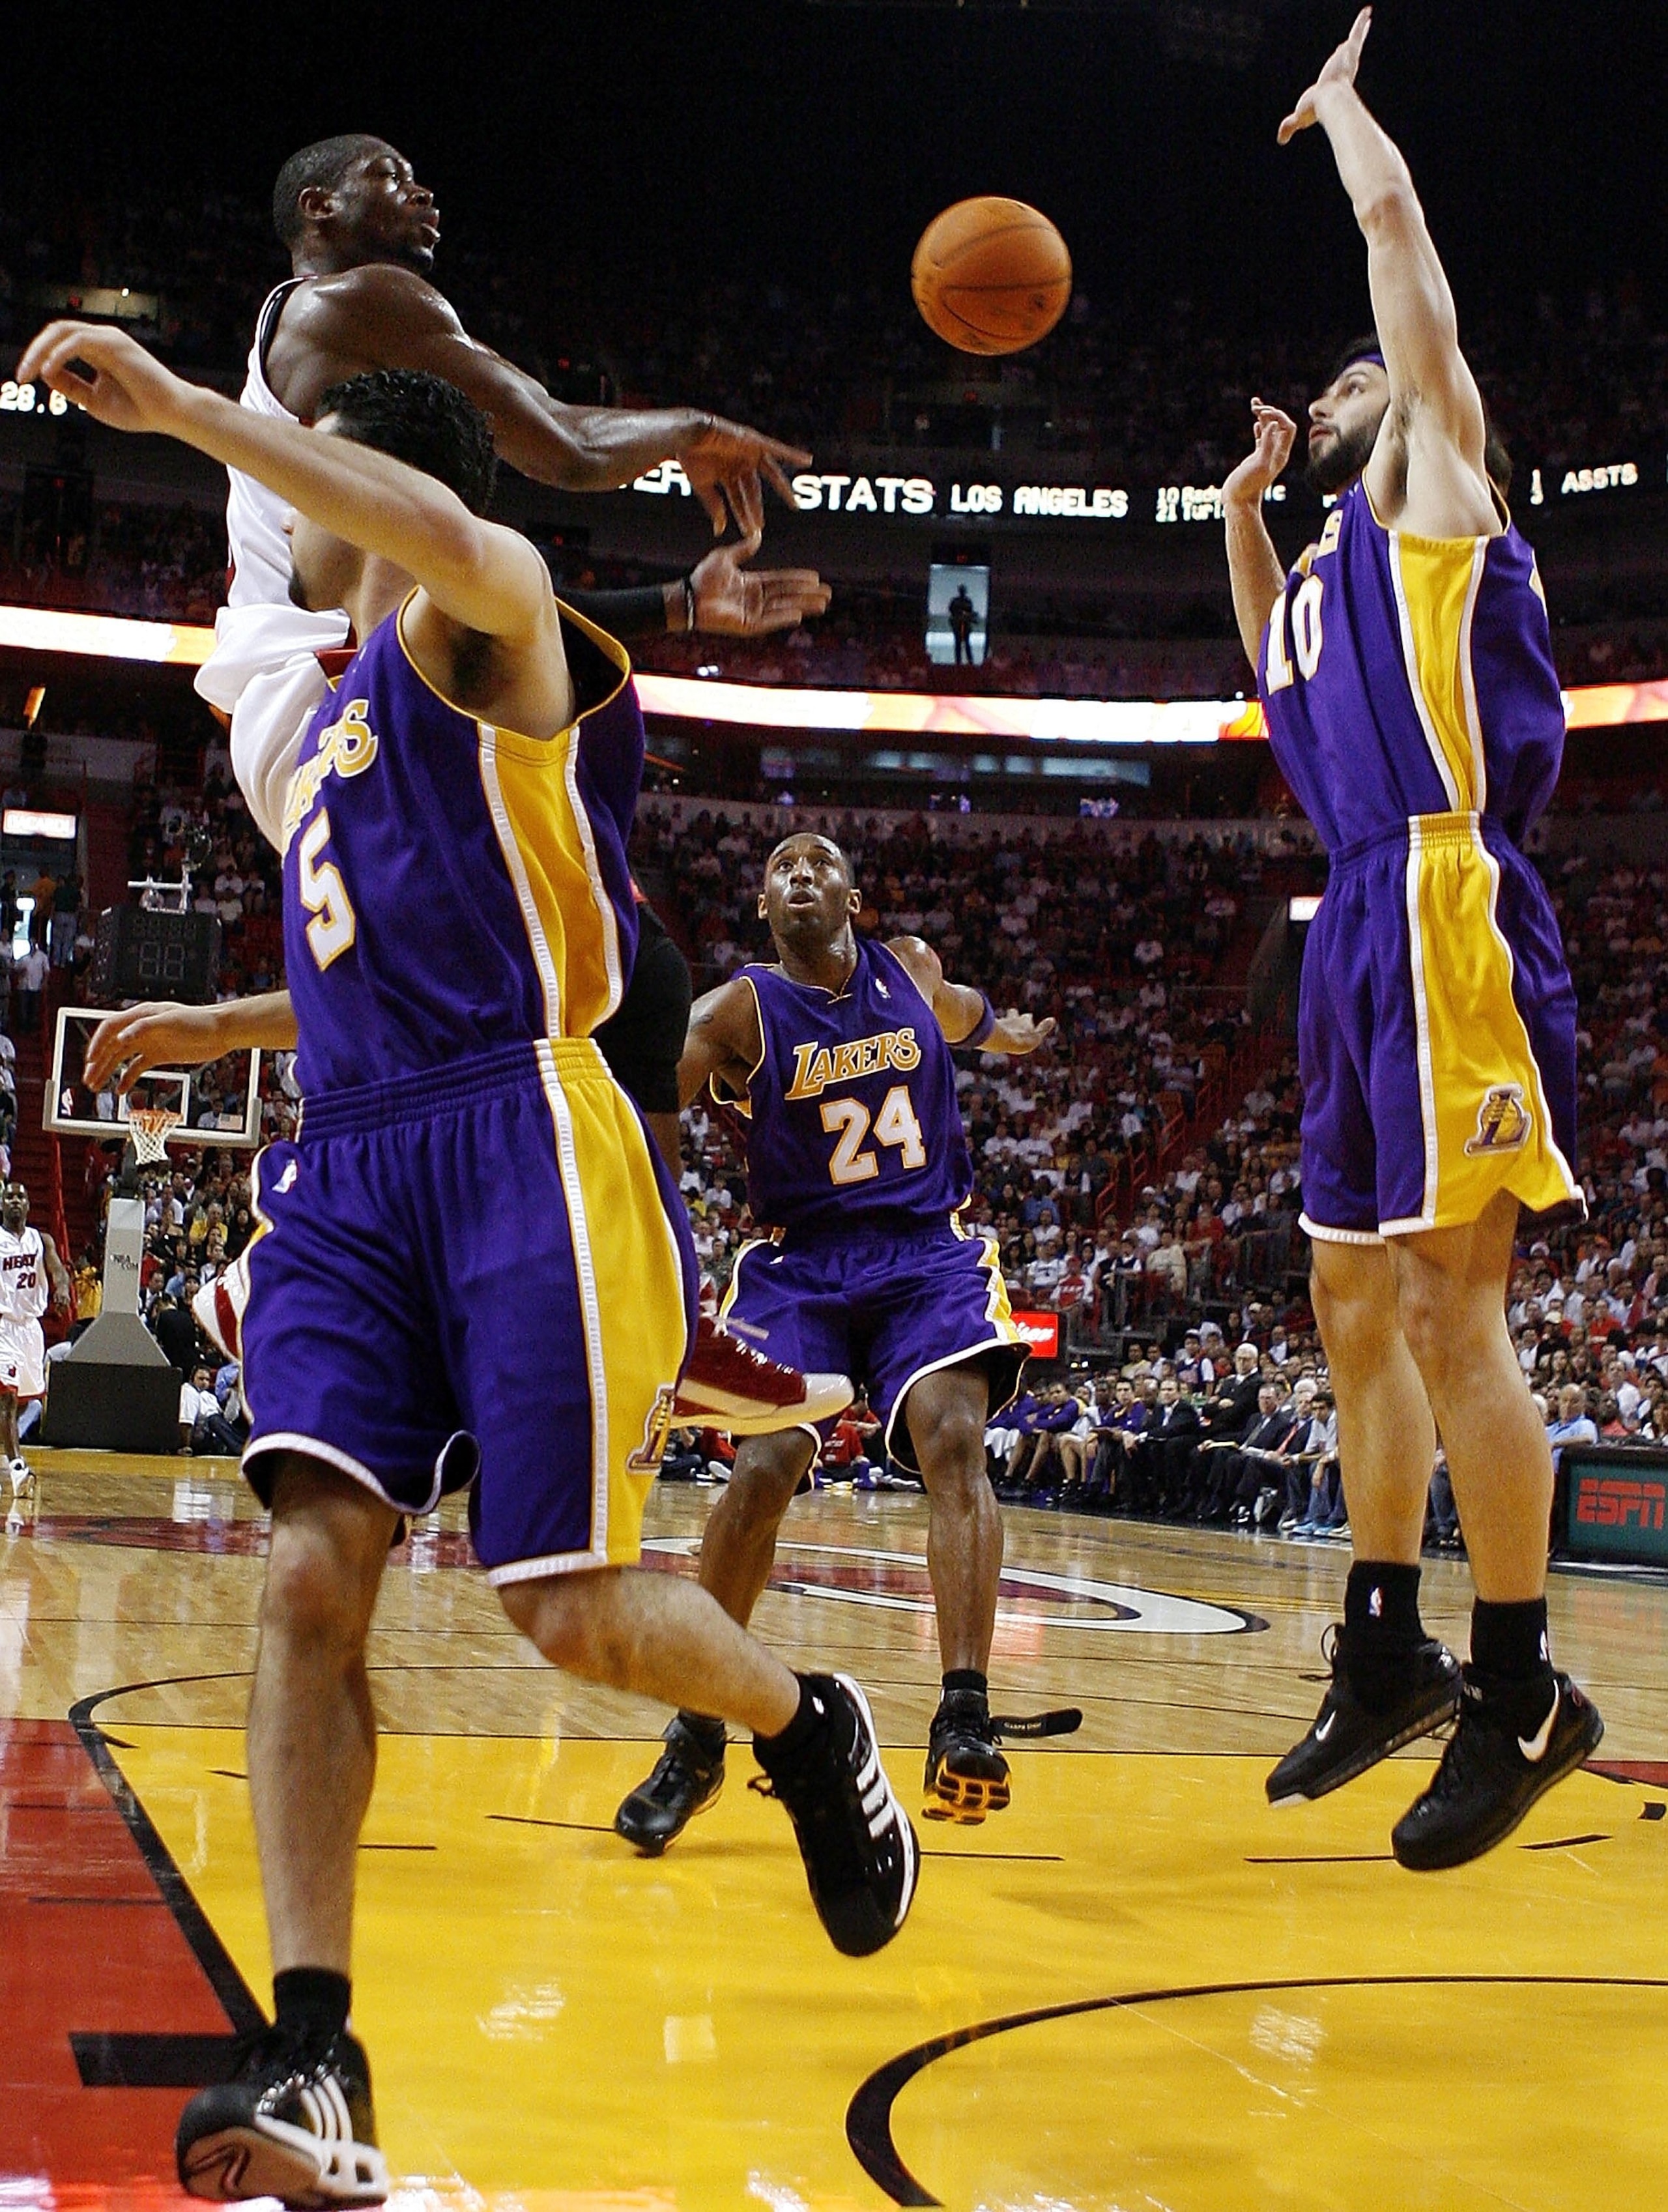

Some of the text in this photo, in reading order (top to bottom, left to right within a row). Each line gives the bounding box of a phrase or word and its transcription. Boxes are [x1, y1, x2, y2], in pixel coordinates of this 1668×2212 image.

[792, 474, 934, 515] STATS
[951, 483, 1003, 513] LOS
[1013, 486, 1129, 519] ANGELES
[1265, 573, 1324, 696] 10
[299, 805, 356, 972] 5
[784, 1027, 921, 1100] LAKERS
[820, 1085, 927, 1185] 24
[3, 1249, 38, 1271] HEAT
[16, 1272, 36, 1289] 20
[1576, 1478, 1666, 1529] ESPN
